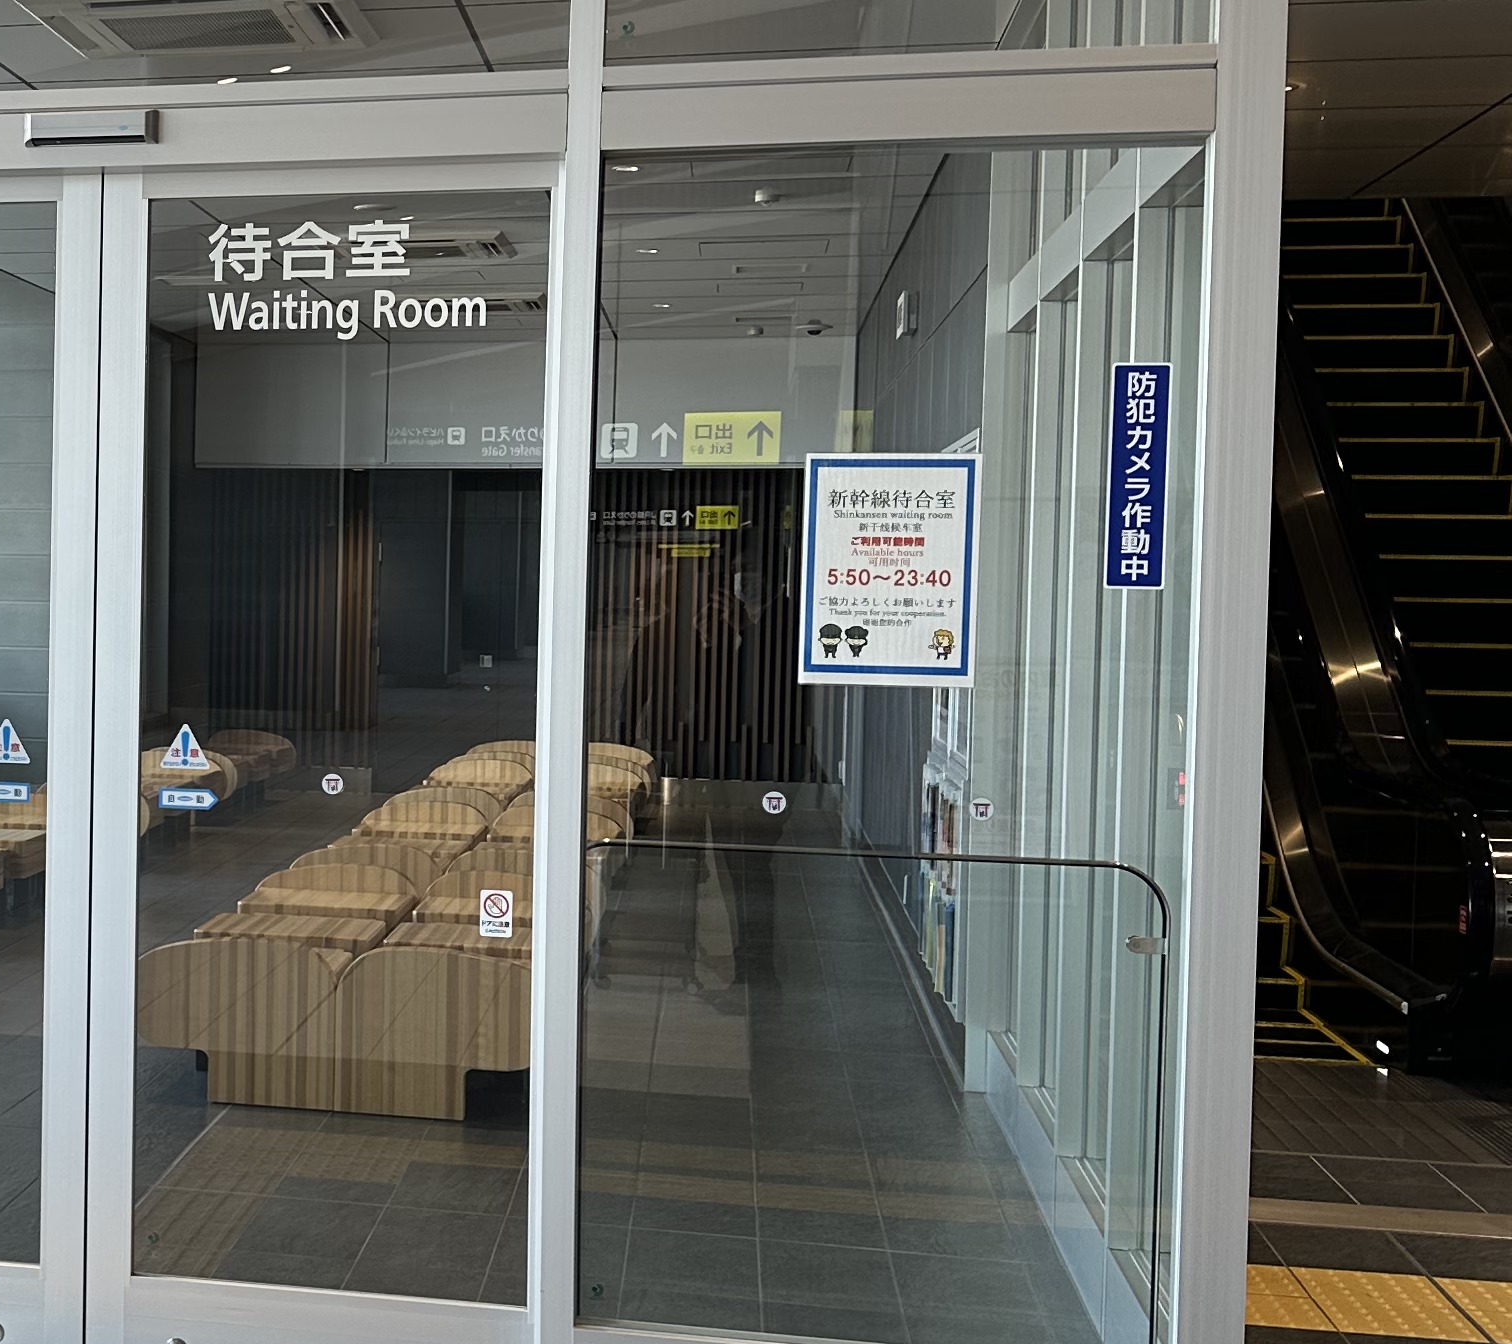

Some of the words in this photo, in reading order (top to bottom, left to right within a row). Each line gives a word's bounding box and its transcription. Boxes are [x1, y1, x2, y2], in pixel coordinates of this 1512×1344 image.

[208, 219, 411, 282] 待合室
[208, 290, 359, 340] Waiting
[373, 289, 487, 328] Room
[1120, 371, 1157, 581] 防犯カメラ作動中
[827, 488, 956, 509] 新幹線待合室
[833, 510, 887, 519] Shinkansen
[890, 510, 925, 521] waiting
[850, 536, 925, 547] ご利用可能時間
[851, 548, 894, 557] Available
[897, 548, 924, 557] hours
[818, 596, 956, 608] ご協力よろしくお願いします
[829, 608, 851, 616] Thank
[854, 609, 868, 617] you
[870, 608, 880, 616] for
[882, 610, 898, 618] your
